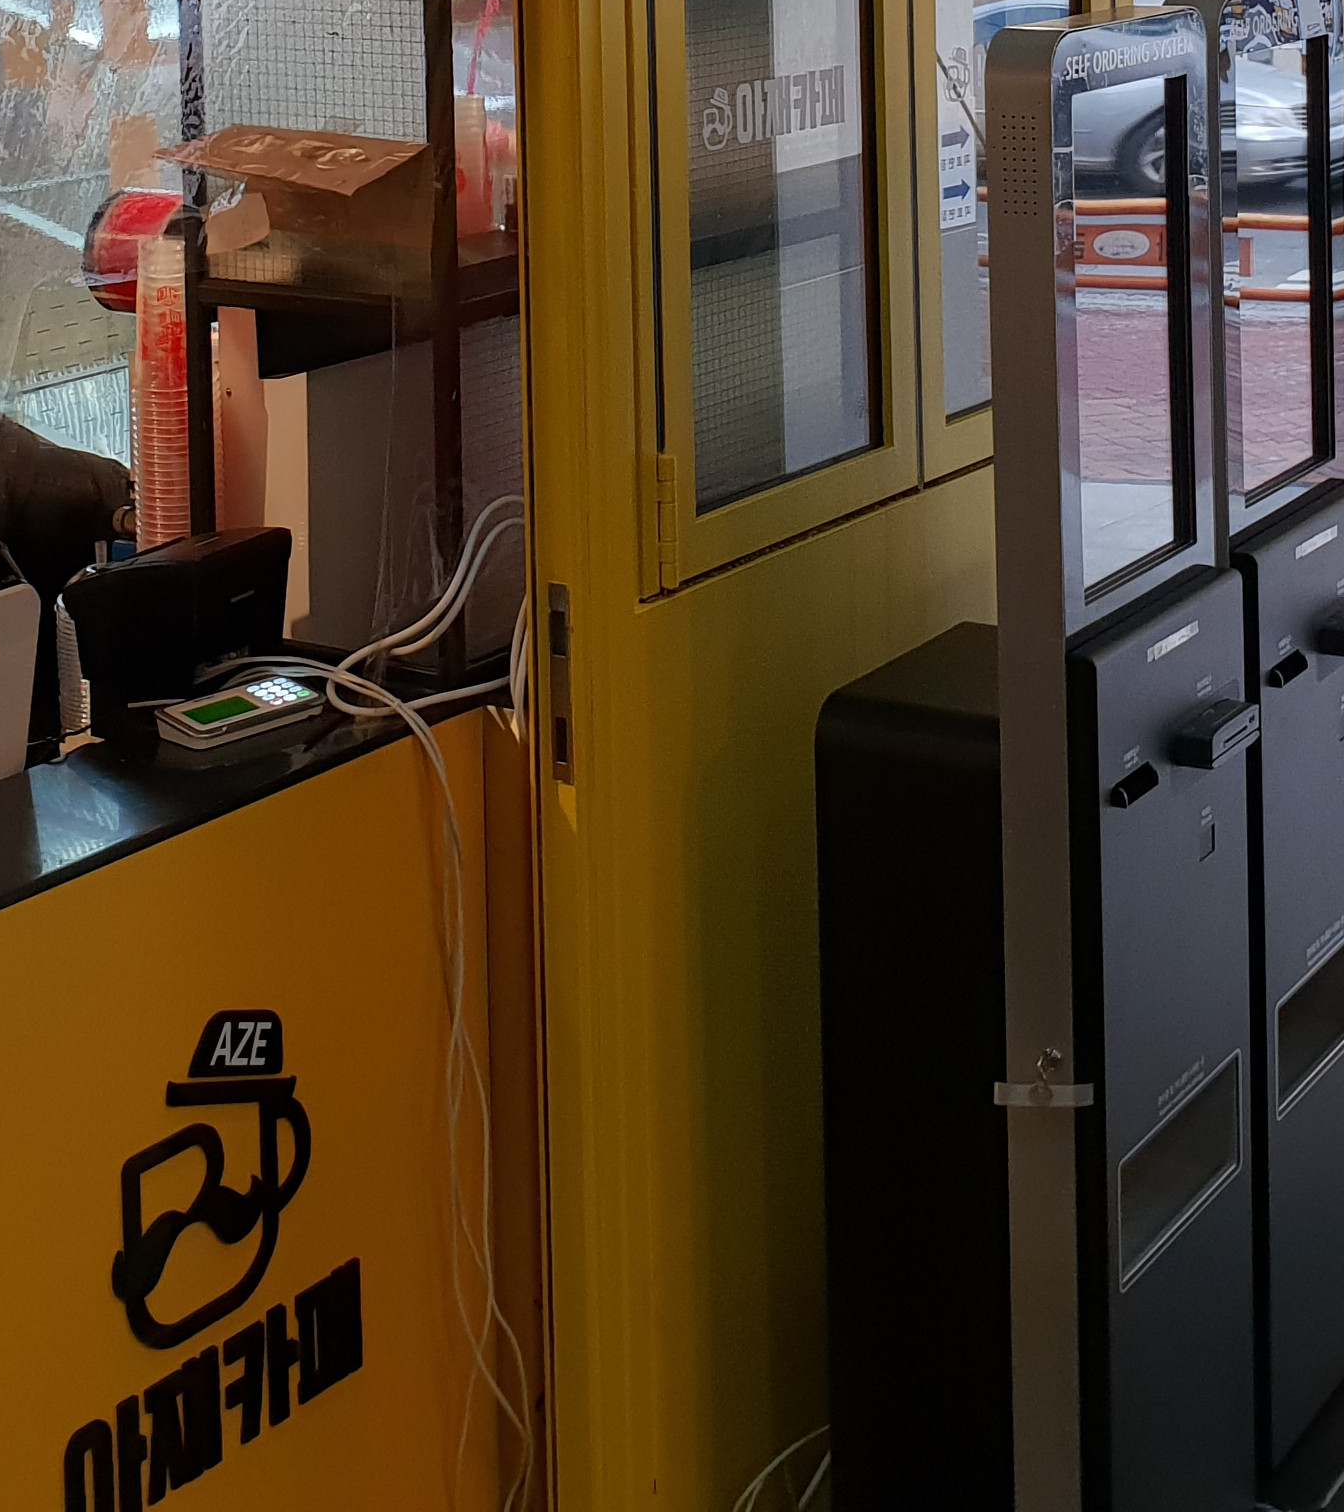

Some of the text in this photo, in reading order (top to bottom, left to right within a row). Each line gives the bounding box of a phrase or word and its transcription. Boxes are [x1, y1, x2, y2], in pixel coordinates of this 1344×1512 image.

[1064, 52, 1091, 81] SELF
[1092, 40, 1151, 73] ORDERING
[736, 64, 846, 144] 아재카페
[210, 1021, 273, 1067] AZE
[62, 1256, 365, 1512] 아재카페
